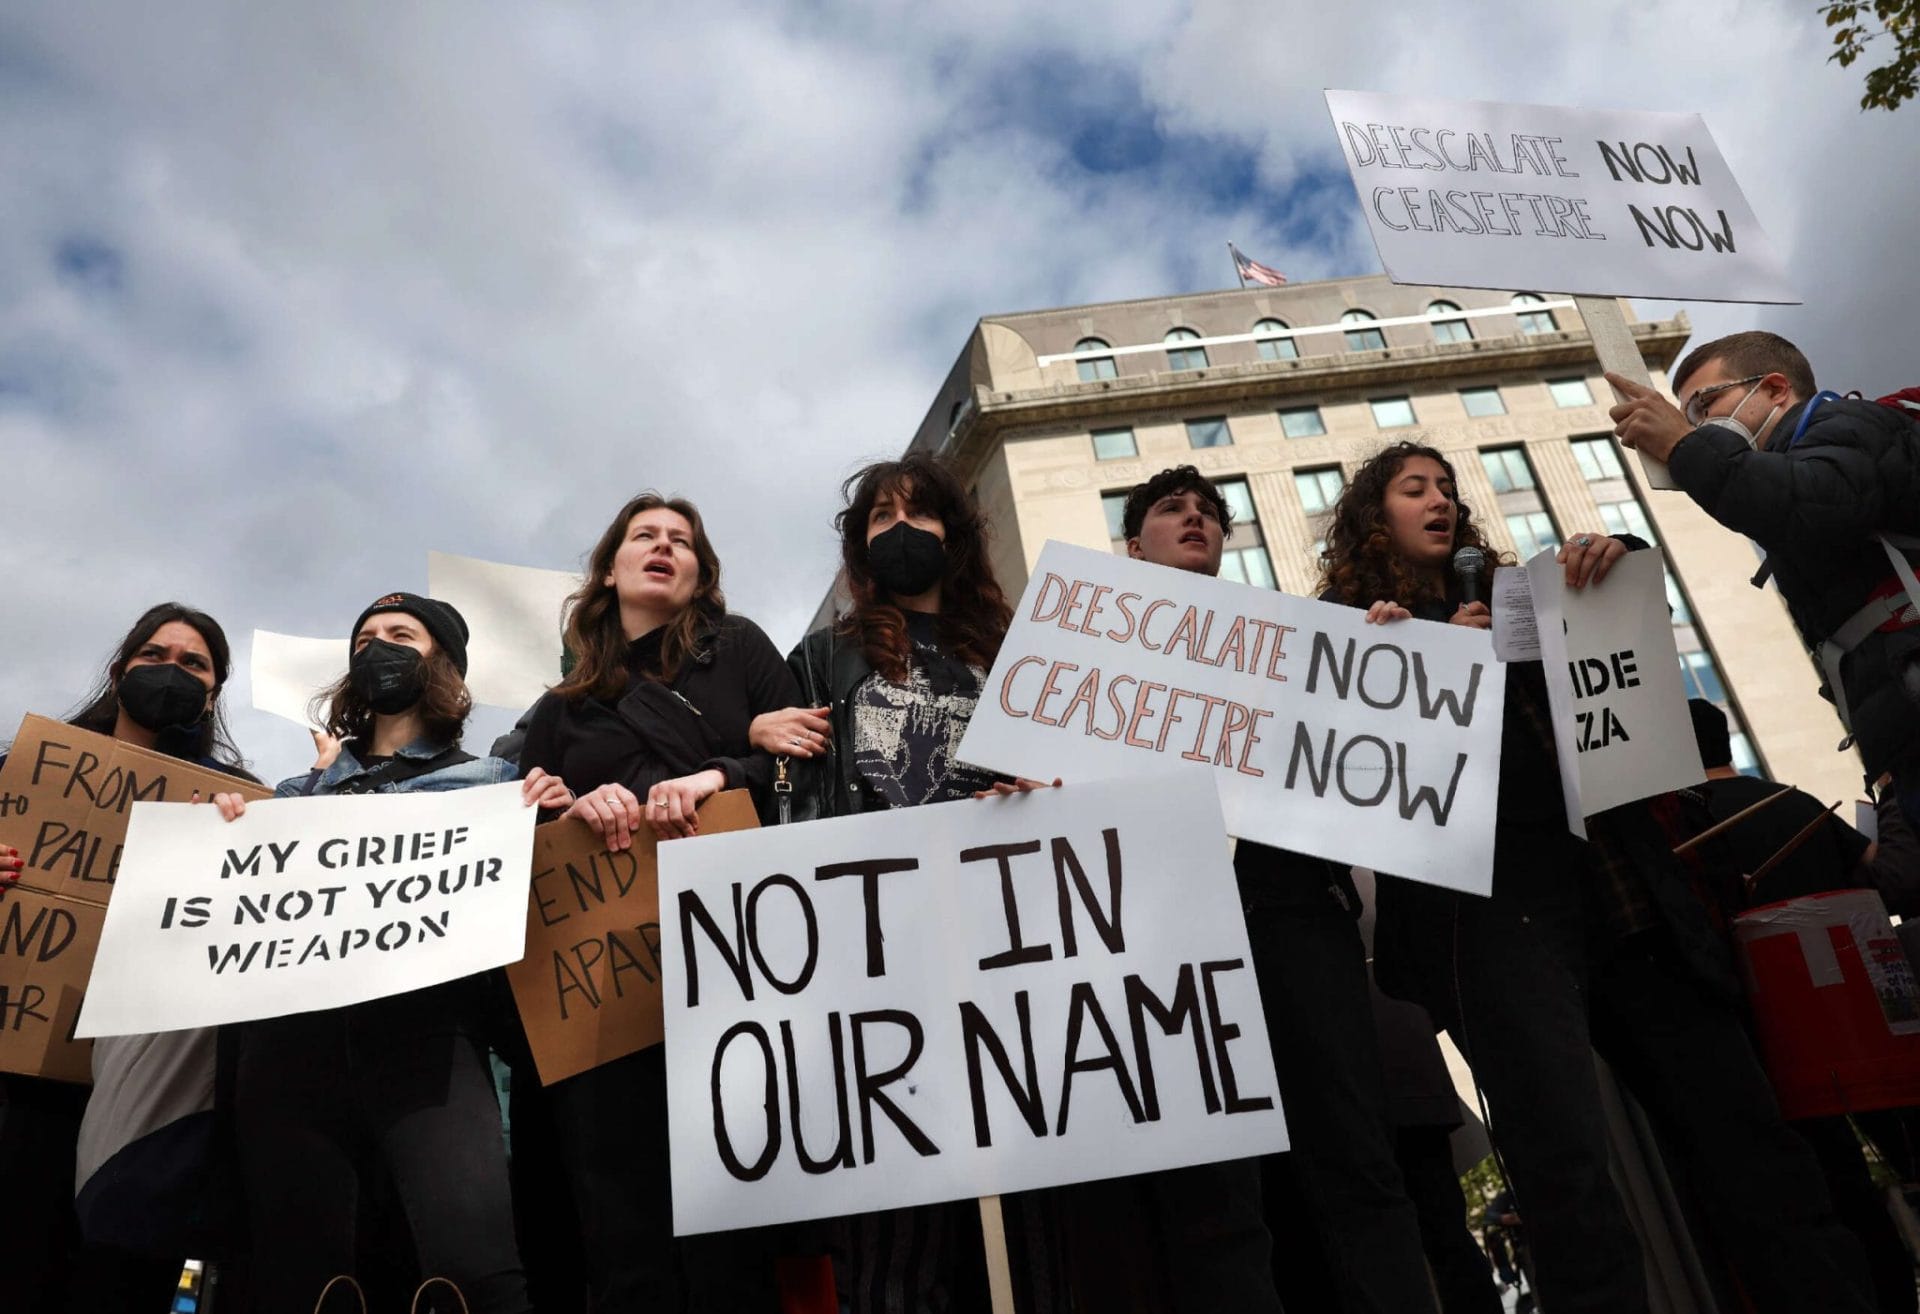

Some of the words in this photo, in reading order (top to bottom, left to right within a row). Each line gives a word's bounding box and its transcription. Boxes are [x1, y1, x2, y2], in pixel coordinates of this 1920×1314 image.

[1342, 121, 1580, 178] DEESCALATE
[1597, 140, 1701, 186] NOW
[1372, 187, 1607, 241] CEASEFIRE
[1628, 203, 1737, 254] NOW
[1030, 571, 1298, 683] DEESCALATE
[1305, 630, 1484, 727] NOW
[1000, 655, 1274, 777] CEASEFIRE
[1284, 720, 1469, 827] NOW
[1576, 707, 1630, 753] ZA
[31, 740, 167, 813] FROM
[220, 840, 300, 879] MY
[317, 827, 469, 869] GRIEF
[531, 849, 638, 927] END
[160, 896, 213, 929] IS
[233, 886, 347, 925] NOT
[365, 857, 504, 909] YOUR
[677, 857, 919, 1008] NOT
[960, 827, 1126, 971] IN
[207, 910, 450, 975] WEAPON
[710, 1009, 941, 1182] OUR
[959, 957, 1275, 1148] NAME
